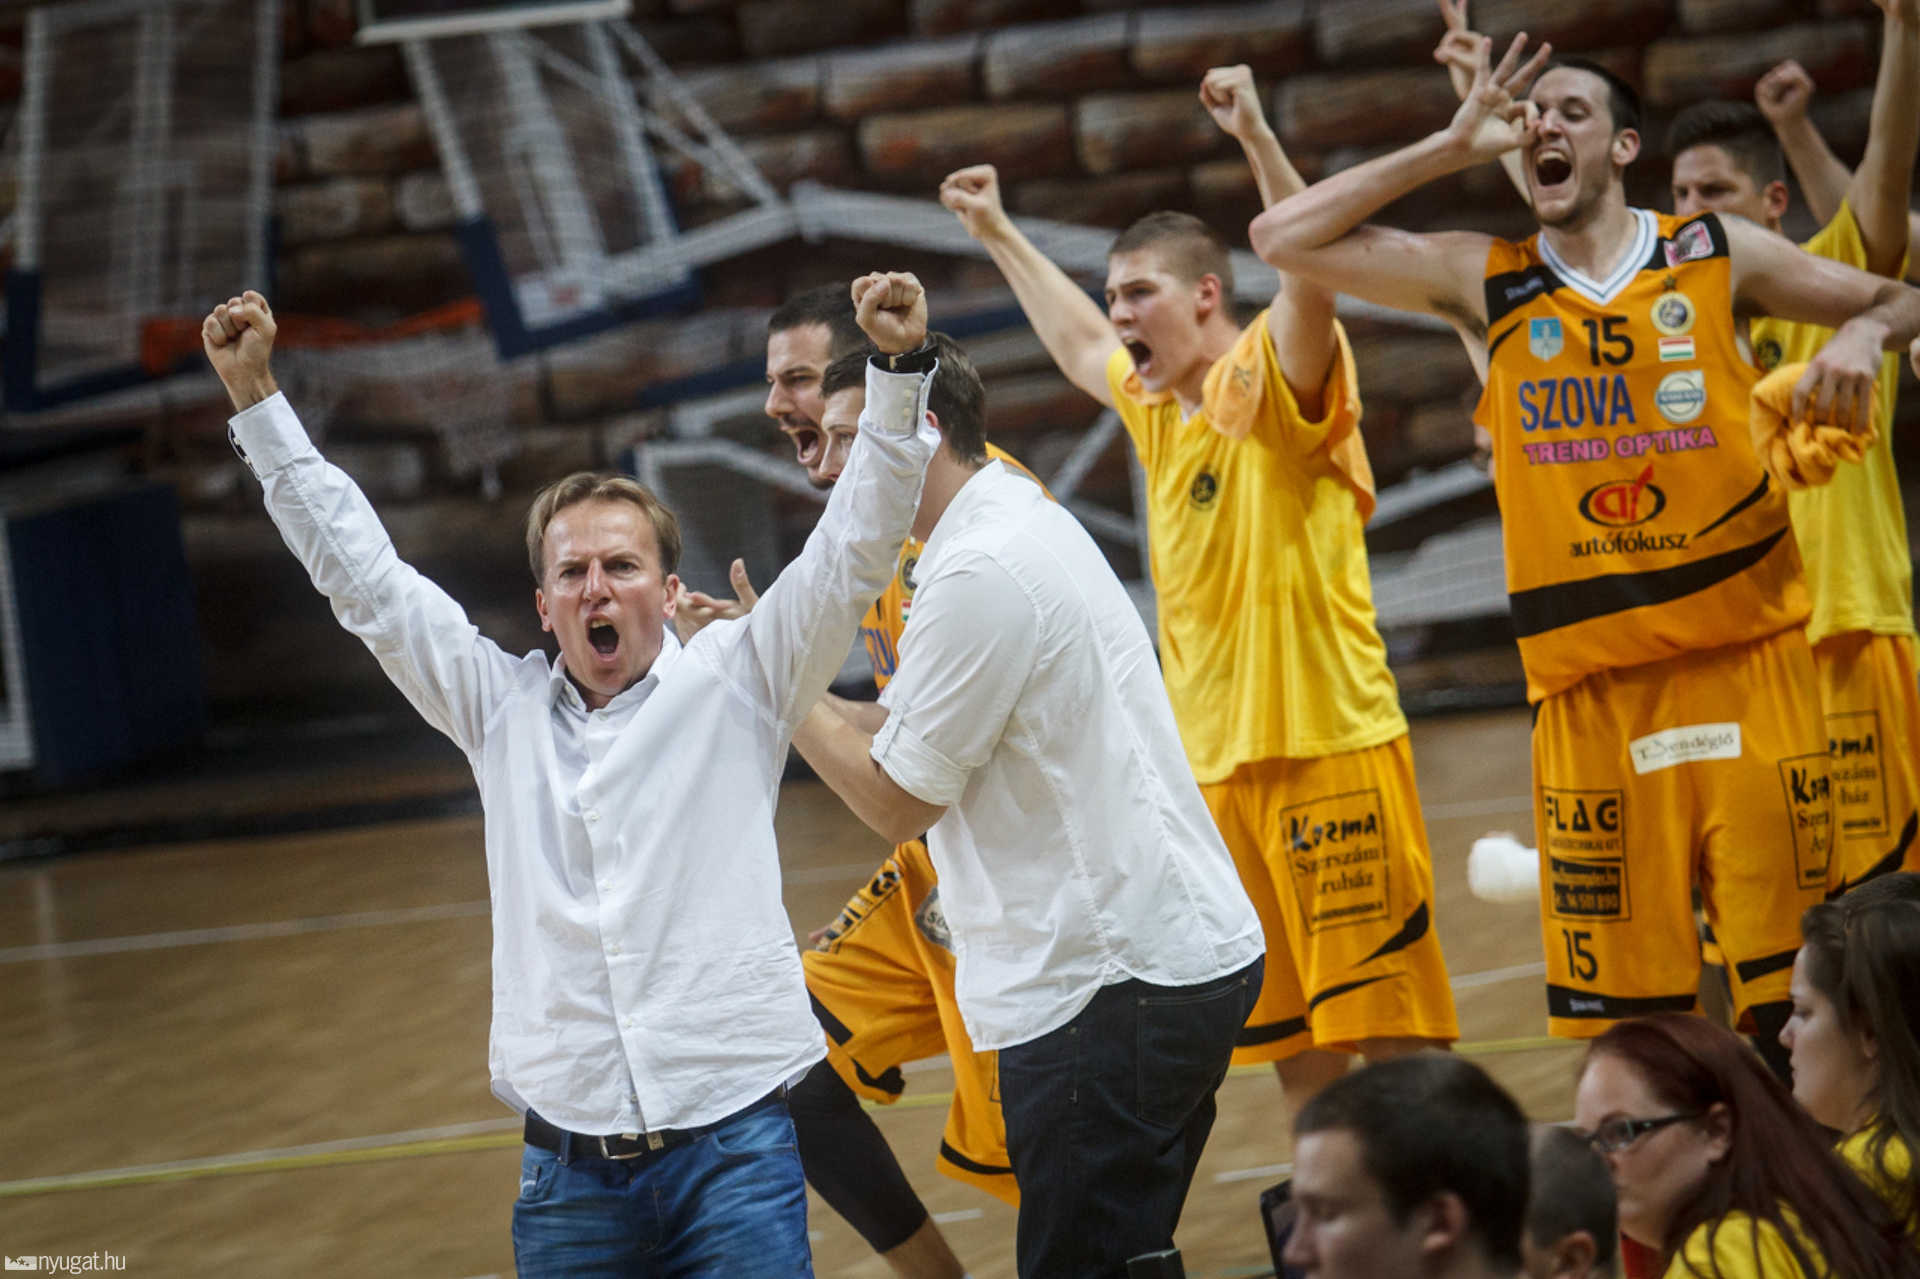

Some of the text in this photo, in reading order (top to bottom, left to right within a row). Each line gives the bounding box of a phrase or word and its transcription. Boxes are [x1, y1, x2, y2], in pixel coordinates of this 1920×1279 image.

[1582, 316, 1634, 366] 15
[1518, 374, 1636, 432] SZOVA
[1523, 426, 1718, 465] TREND OPTIKA
[1562, 929, 1598, 982] 15
